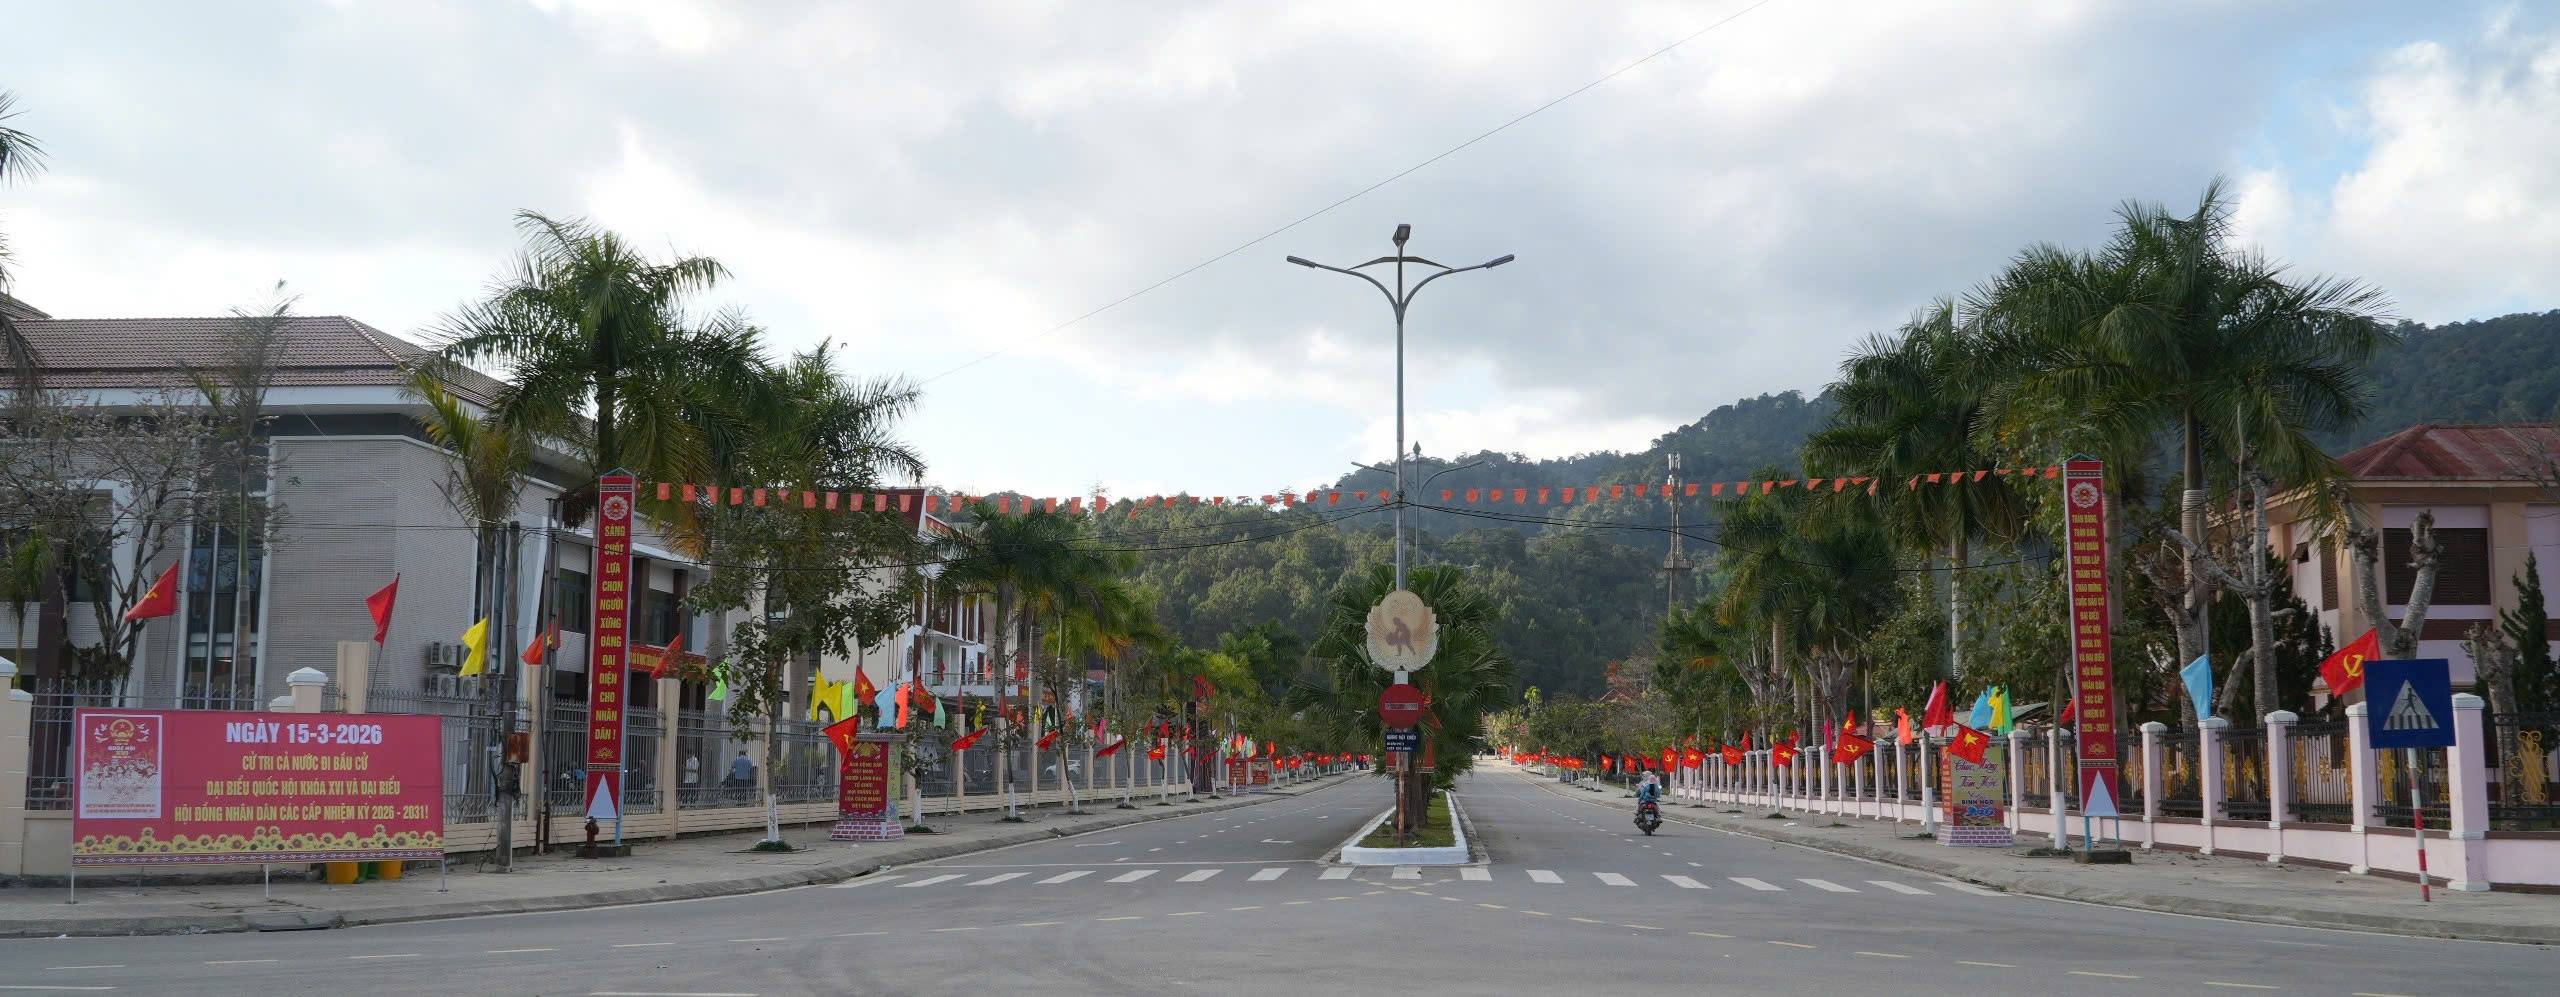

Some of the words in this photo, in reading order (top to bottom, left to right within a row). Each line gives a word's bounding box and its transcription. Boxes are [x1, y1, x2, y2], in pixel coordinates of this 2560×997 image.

[606, 562, 620, 575] LỰA
[602, 580, 623, 594] CHỌN
[600, 598, 624, 611] NGƯỜI
[600, 616, 621, 630] XỨNG
[602, 654, 616, 667] ĐẠI
[600, 692, 616, 702] CHO
[596, 708, 617, 722] NHÂN
[226, 718, 280, 743] NGÀY
[287, 724, 382, 744] 15-3-2026
[595, 726, 611, 740] DÂN
[242, 751, 257, 770] CỬ
[259, 756, 274, 770] TRI
[277, 751, 289, 770] CẢ
[292, 752, 318, 770] NƯỚC
[321, 756, 330, 770] ĐI
[355, 752, 368, 770] CỬ
[206, 780, 224, 799] ĐẠI
[226, 776, 249, 795] BIỂU
[253, 776, 278, 797] QUỐC
[281, 778, 297, 798] HỘI
[300, 778, 325, 795] KHÓA
[329, 781, 343, 795] XVI
[347, 778, 358, 795] VÀ
[361, 781, 376, 798] ĐẠI
[379, 776, 400, 795] BIỂU
[174, 804, 192, 825] HỘI
[225, 803, 254, 821] NHÂN
[256, 803, 277, 820] DÂN
[280, 803, 299, 820] CÁC
[302, 801, 321, 820] CẤP
[324, 803, 354, 824] NHIỆM
[357, 803, 369, 819] KỲ
[372, 806, 394, 819] 2026
[403, 805, 428, 819] 2031!
